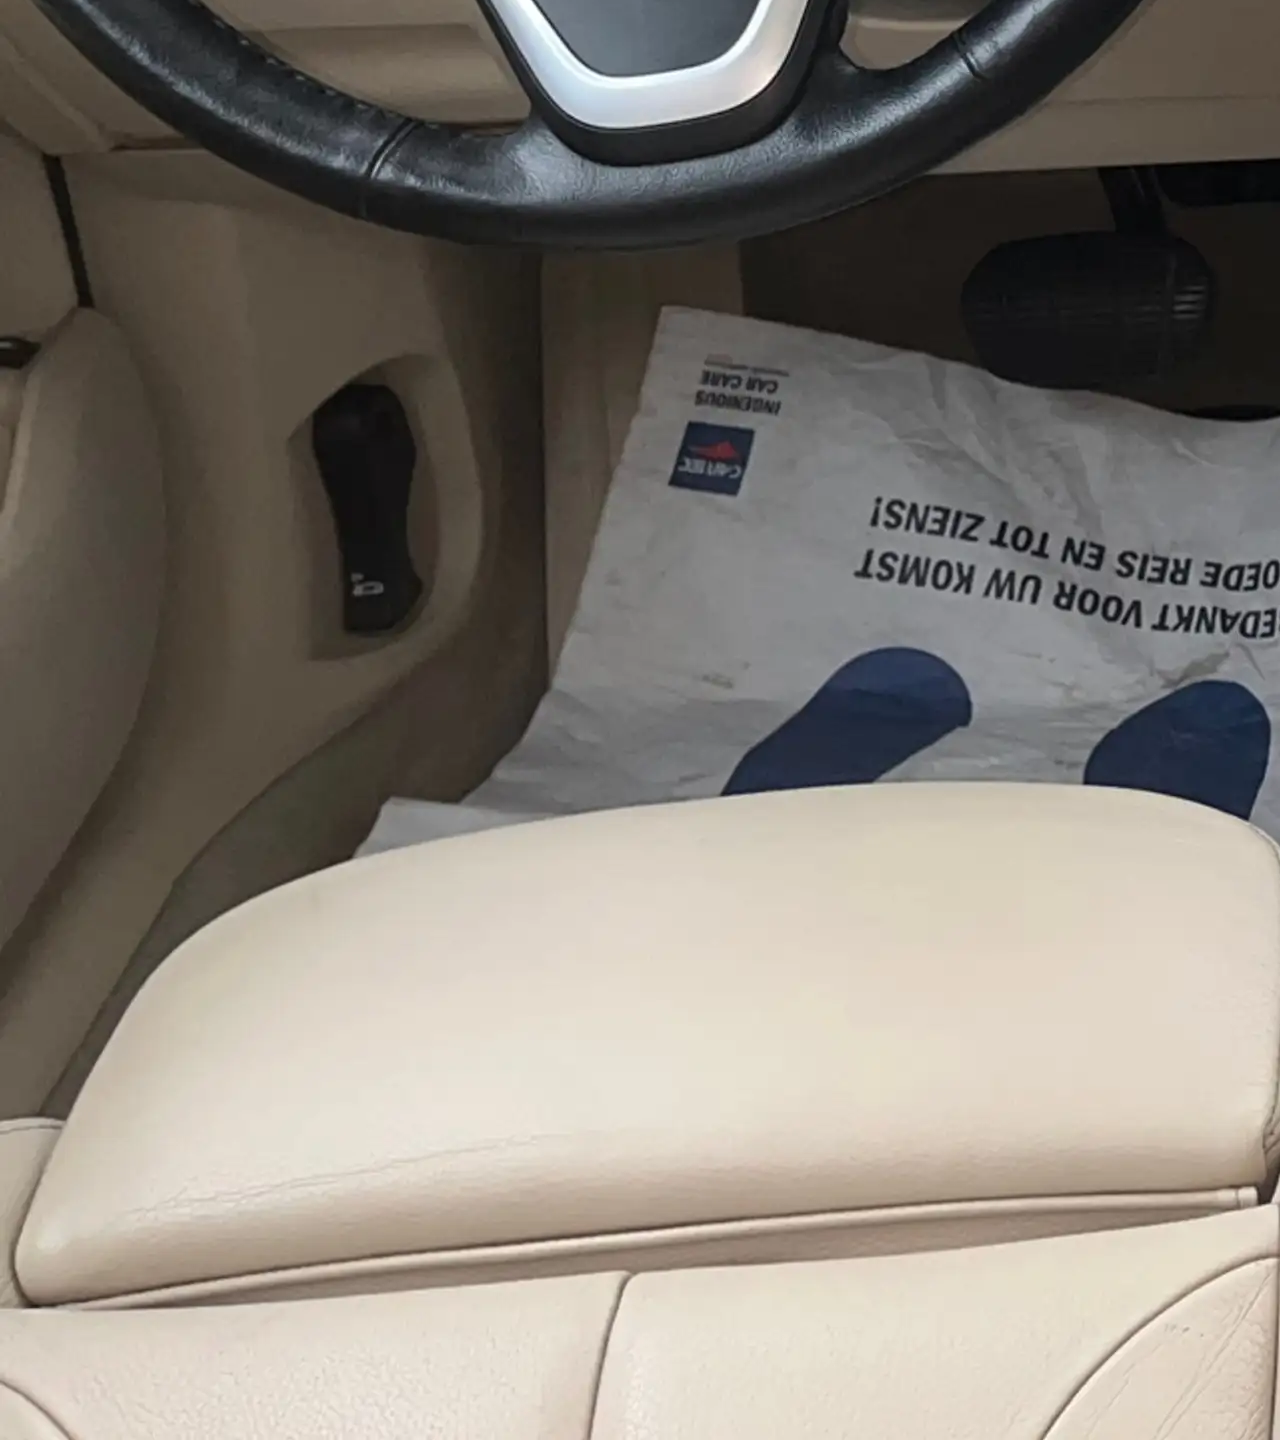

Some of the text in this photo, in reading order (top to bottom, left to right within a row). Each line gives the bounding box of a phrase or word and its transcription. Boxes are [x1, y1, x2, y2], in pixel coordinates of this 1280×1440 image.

[694, 389, 782, 416] INGENIOUS
[745, 378, 779, 394] CAR
[869, 495, 985, 543] ZIENS!
[989, 519, 1051, 560] TOT
[1061, 537, 1106, 572] EN
[853, 548, 976, 597] KOMST
[983, 567, 1042, 605] UW
[1115, 549, 1190, 586] REIS
[1052, 579, 1143, 630] VOOR
